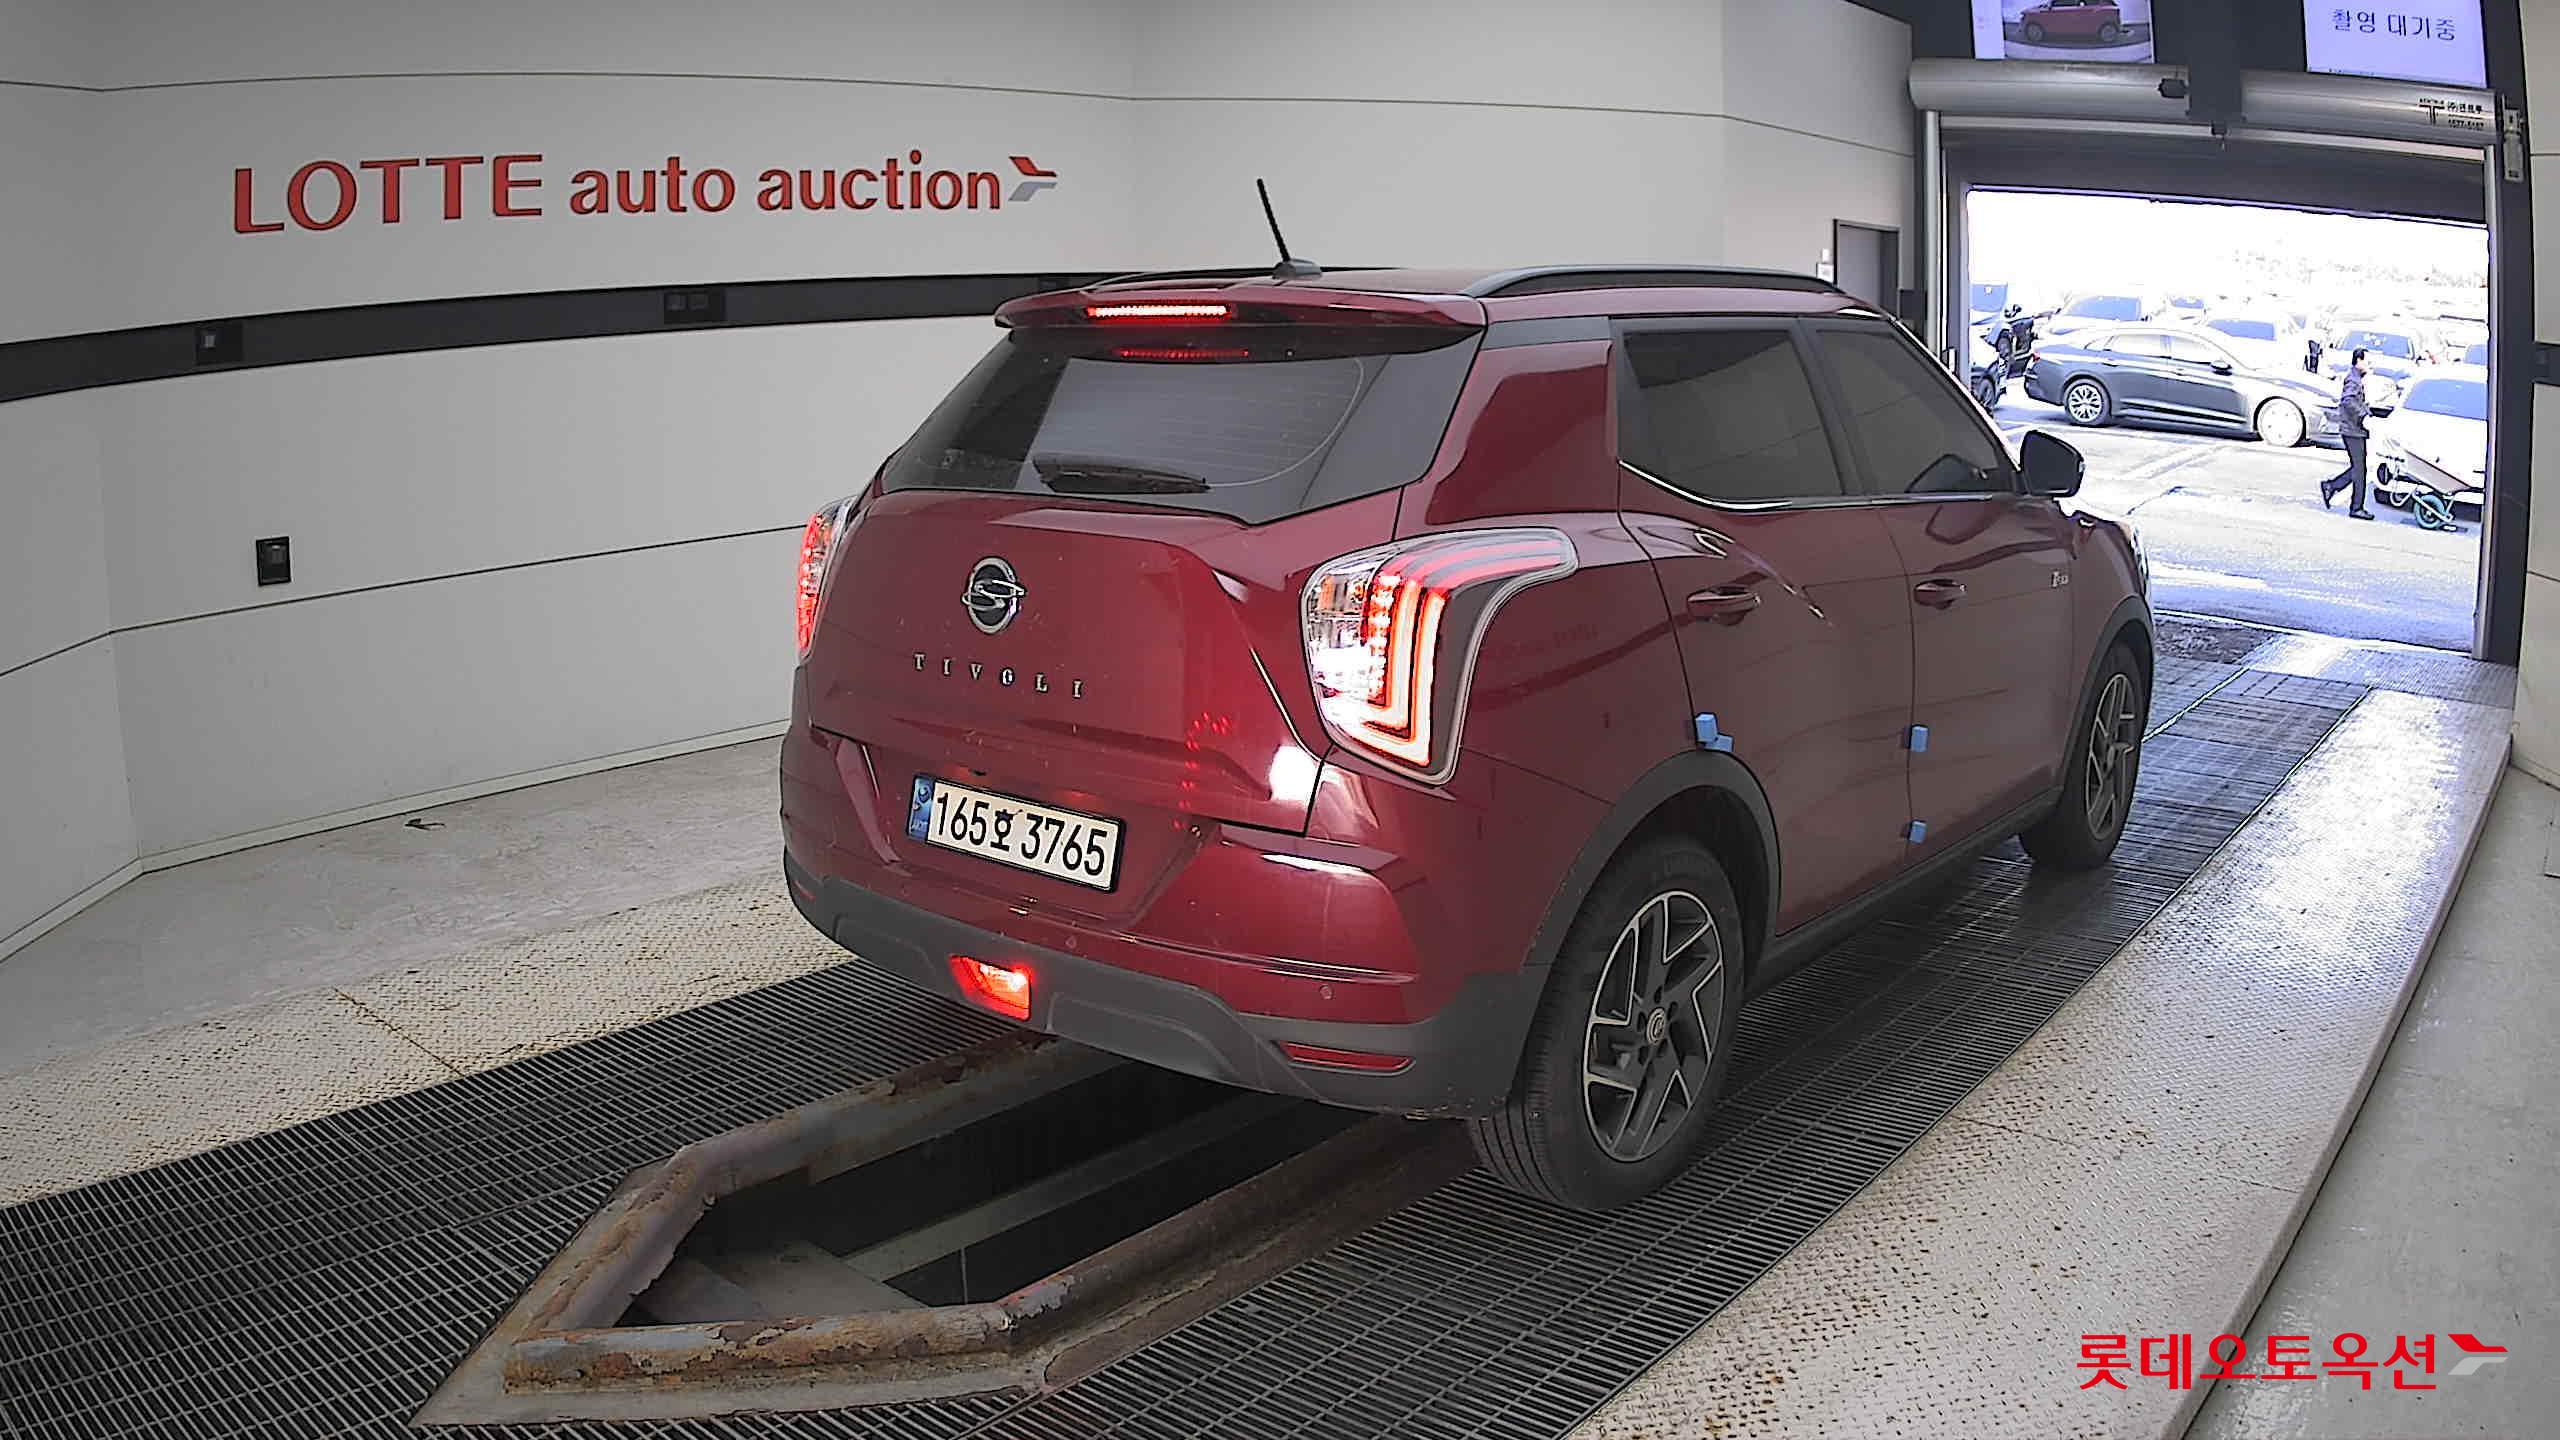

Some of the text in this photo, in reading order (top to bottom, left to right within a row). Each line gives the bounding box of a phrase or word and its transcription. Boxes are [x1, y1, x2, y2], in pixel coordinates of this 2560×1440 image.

[2333, 9, 2456, 41] 촬영 대기중
[234, 150, 1002, 233] LOTTE auto auction
[913, 653, 1082, 698] TIVOLI
[1020, 814, 1108, 877] 3765
